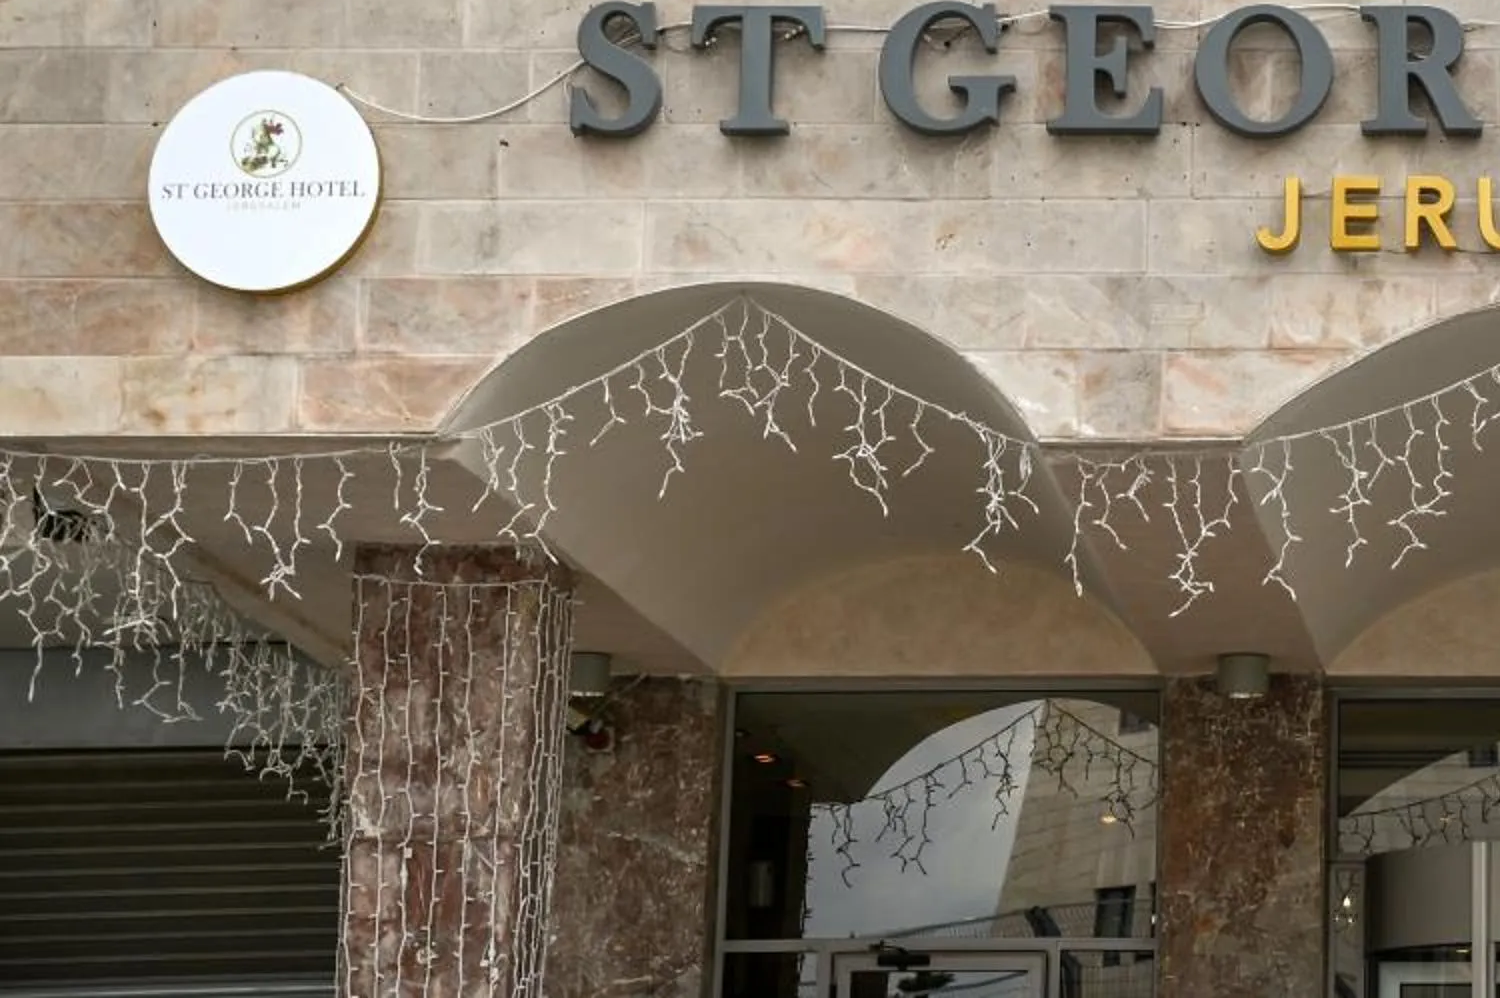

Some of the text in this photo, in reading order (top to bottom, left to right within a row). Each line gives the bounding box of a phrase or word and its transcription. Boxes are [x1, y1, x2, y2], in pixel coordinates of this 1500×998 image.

[570, 0, 826, 139] ST
[161, 180, 366, 200] ST GEORGE HOTEL
